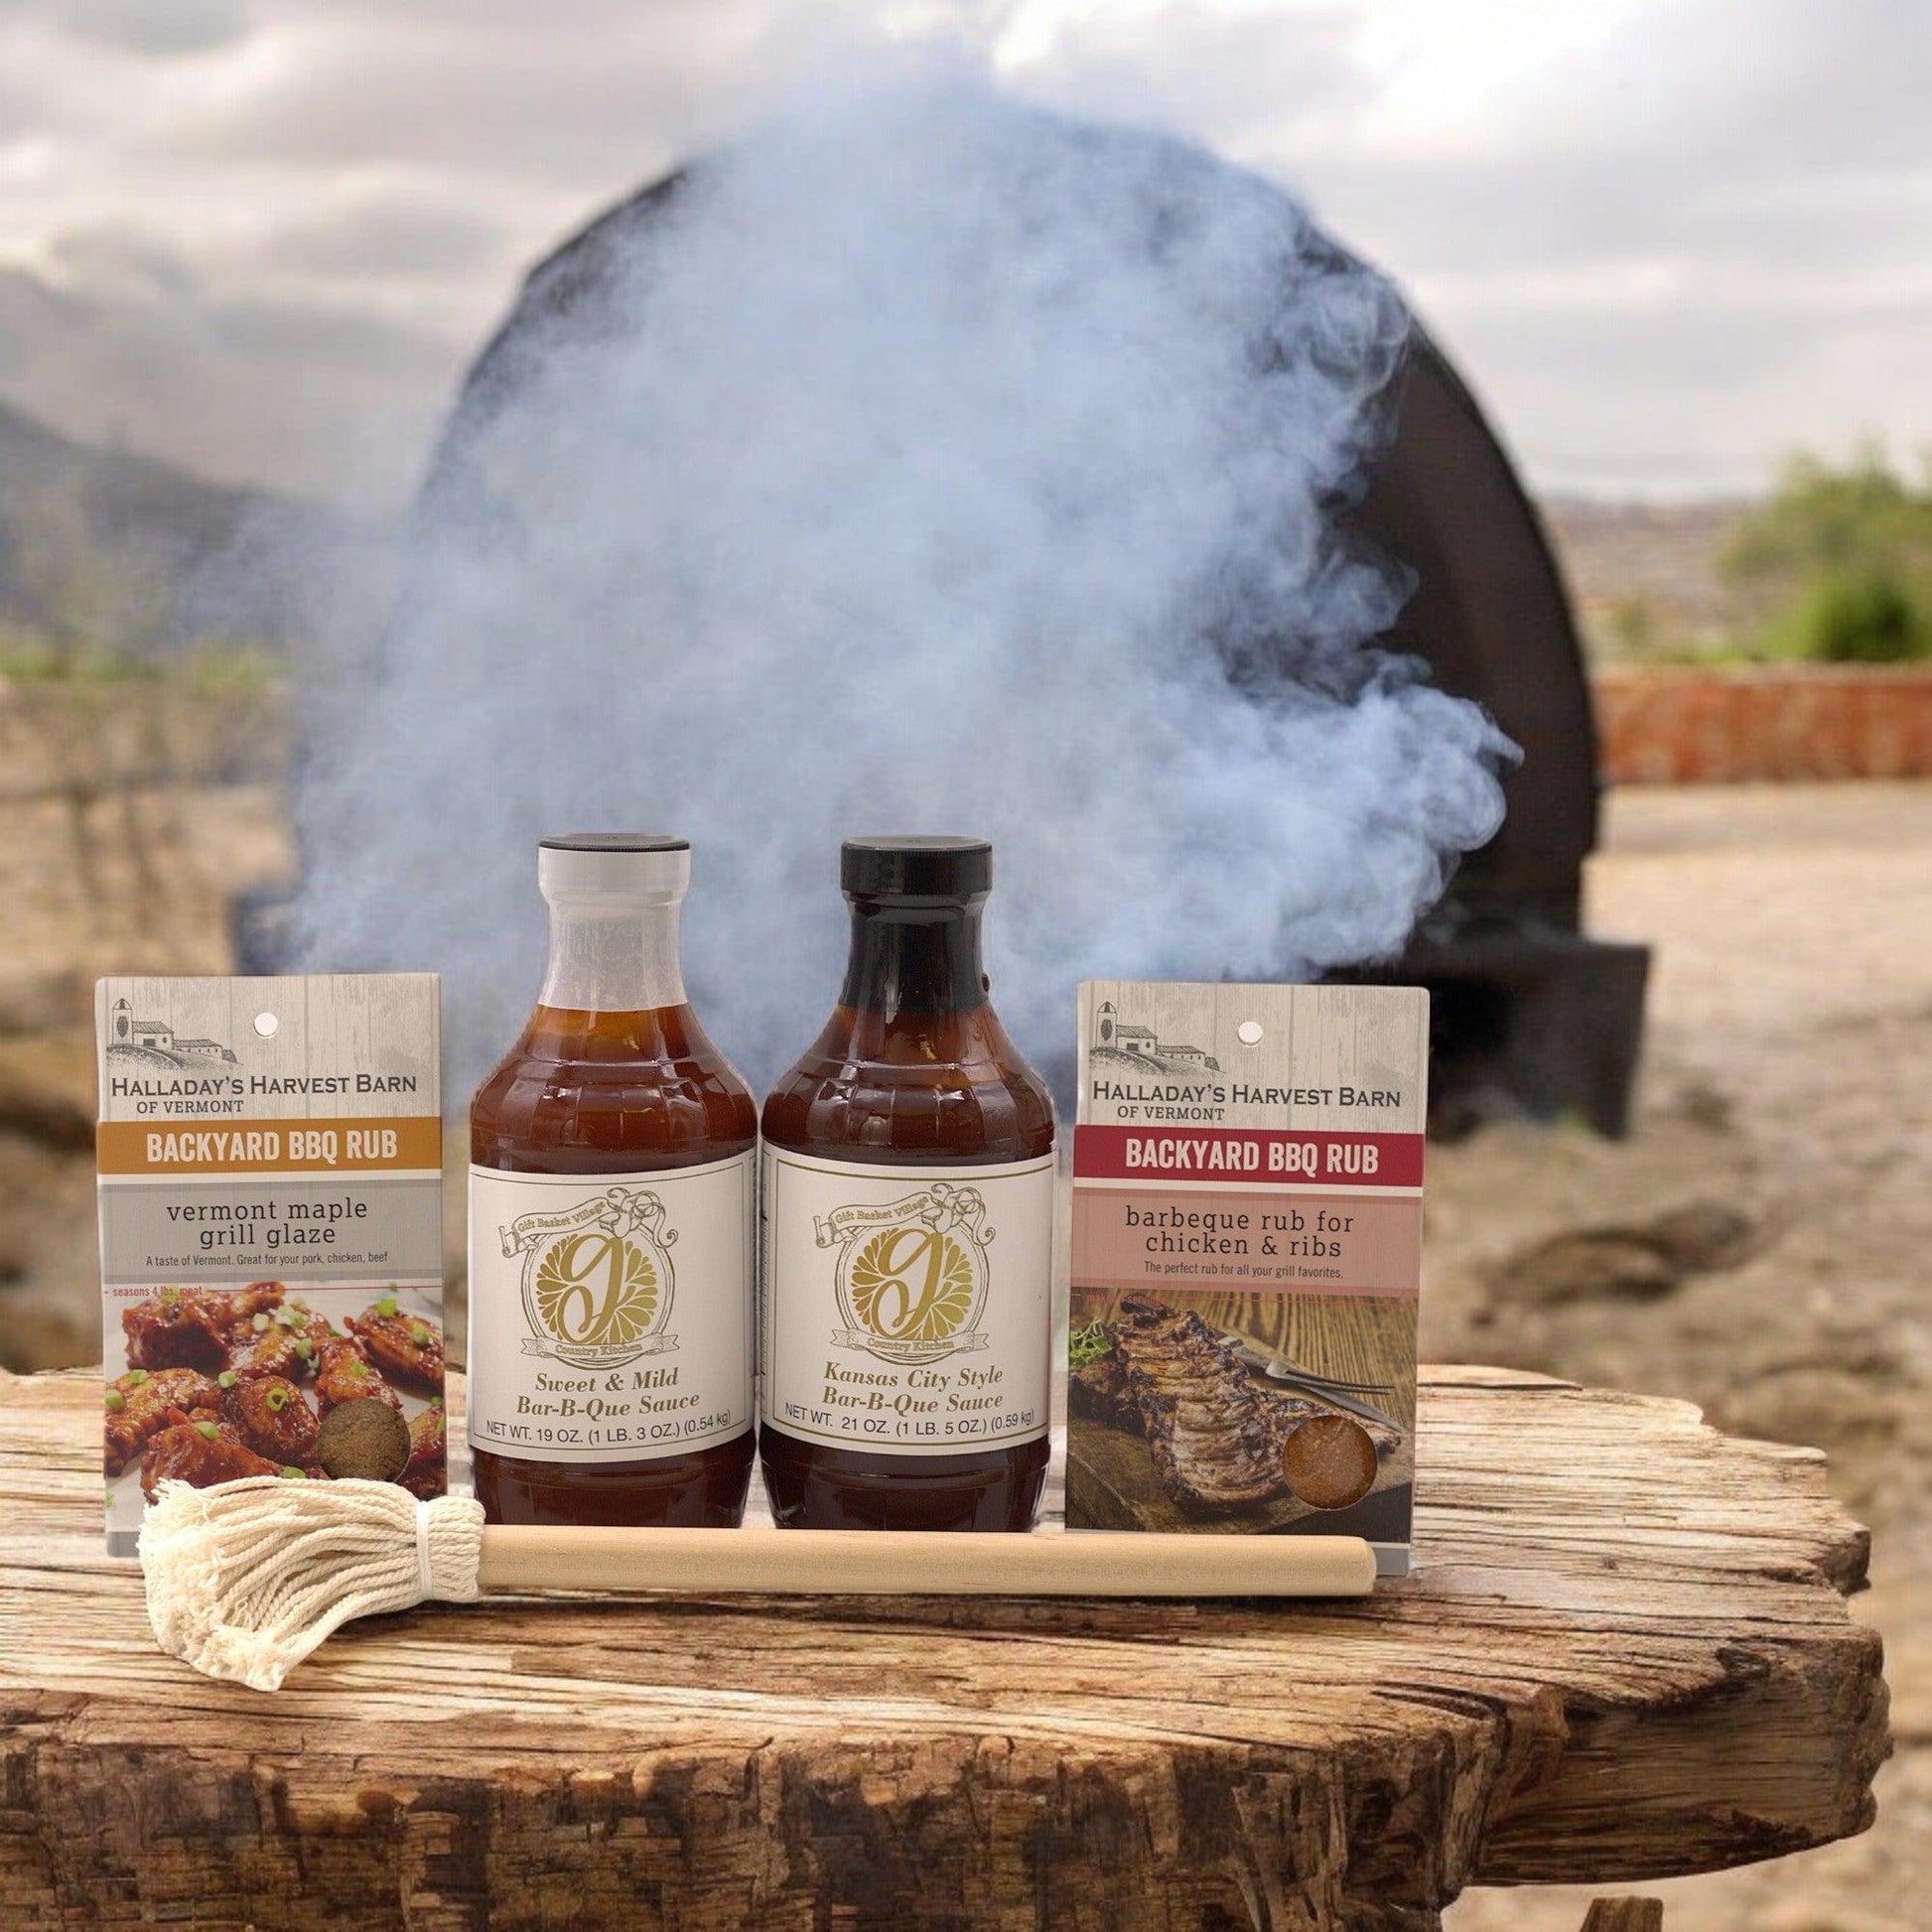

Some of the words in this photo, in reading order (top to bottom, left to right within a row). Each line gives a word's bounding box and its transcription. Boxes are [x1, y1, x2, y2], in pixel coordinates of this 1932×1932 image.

[250, 1074, 350, 1095] HARVEST
[356, 1073, 417, 1093] BARN
[1232, 1084, 1333, 1106] HARVEST
[1338, 1087, 1401, 1108] BARN
[136, 1101, 158, 1114] OF
[163, 1100, 244, 1114] VERMONT
[1117, 1105, 1139, 1119] OF
[1144, 1106, 1225, 1121] VERMONT
[146, 1131, 280, 1163] BACKYARD
[288, 1130, 338, 1166] BBQ
[346, 1130, 398, 1160] RUB
[1125, 1138, 1260, 1172] BACKYARD
[1268, 1142, 1317, 1177] BBQ
[1326, 1144, 1379, 1174] RUB
[167, 1200, 277, 1221] vermont
[288, 1197, 367, 1222] maple
[1125, 1205, 1250, 1233] barbeque
[1261, 1209, 1306, 1232] rub
[1316, 1210, 1354, 1233] for
[200, 1224, 255, 1250] grill
[266, 1223, 336, 1249] glaze
[1146, 1231, 1249, 1254] chicken
[1261, 1234, 1279, 1255] &
[1289, 1236, 1342, 1258] ribs
[146, 1255, 153, 1266] A
[155, 1256, 179, 1267] taste
[182, 1255, 191, 1266] of
[193, 1254, 234, 1266] Vermont.
[237, 1254, 261, 1265] Great
[265, 1254, 278, 1265] for
[279, 1255, 300, 1266] your
[302, 1253, 325, 1266] pork,
[327, 1252, 365, 1264] chicken,
[368, 1251, 388, 1263] beef
[1144, 1261, 1162, 1273] The
[1165, 1262, 1198, 1275] perfect
[1201, 1263, 1218, 1275] rub
[1220, 1263, 1234, 1275] for
[1236, 1264, 1249, 1276] all
[1251, 1267, 1272, 1278] your
[1275, 1265, 1295, 1279] grill
[1298, 1266, 1343, 1279] favorites.
[112, 1287, 150, 1297] seasons
[555, 1344, 598, 1357] Country
[600, 1343, 643, 1355] Kitchen
[867, 1337, 911, 1353] Country
[911, 1336, 955, 1351] Kitchen
[534, 1372, 597, 1393] Sweet
[605, 1373, 624, 1392] &
[631, 1367, 679, 1390] Mild
[823, 1361, 898, 1388] Kansas
[907, 1369, 951, 1392] City
[957, 1365, 1003, 1390] Style
[516, 1395, 630, 1422] Bar-B-Que
[638, 1393, 700, 1415] Sauce
[822, 1386, 938, 1418] Bar-B-Que
[945, 1393, 1003, 1413] Sauce
[486, 1420, 507, 1438] NET
[508, 1424, 532, 1441] WT.
[537, 1428, 552, 1442] 19
[557, 1430, 583, 1444] OZ.
[589, 1430, 600, 1446] (1
[607, 1428, 631, 1443] LB.
[636, 1427, 646, 1441] 3
[650, 1422, 680, 1439] OZ.)
[684, 1415, 714, 1436] (0.54
[716, 1409, 731, 1428] kg)
[785, 1402, 807, 1422] NET
[809, 1409, 833, 1428] WT.
[841, 1417, 857, 1432] 21
[864, 1420, 891, 1435] OZ.
[897, 1420, 908, 1438] (1
[915, 1421, 939, 1436] LB.
[945, 1420, 954, 1435] 5
[957, 1418, 987, 1435] OZ.)
[991, 1412, 1020, 1433] (0.59
[1021, 1408, 1035, 1426] kg)
